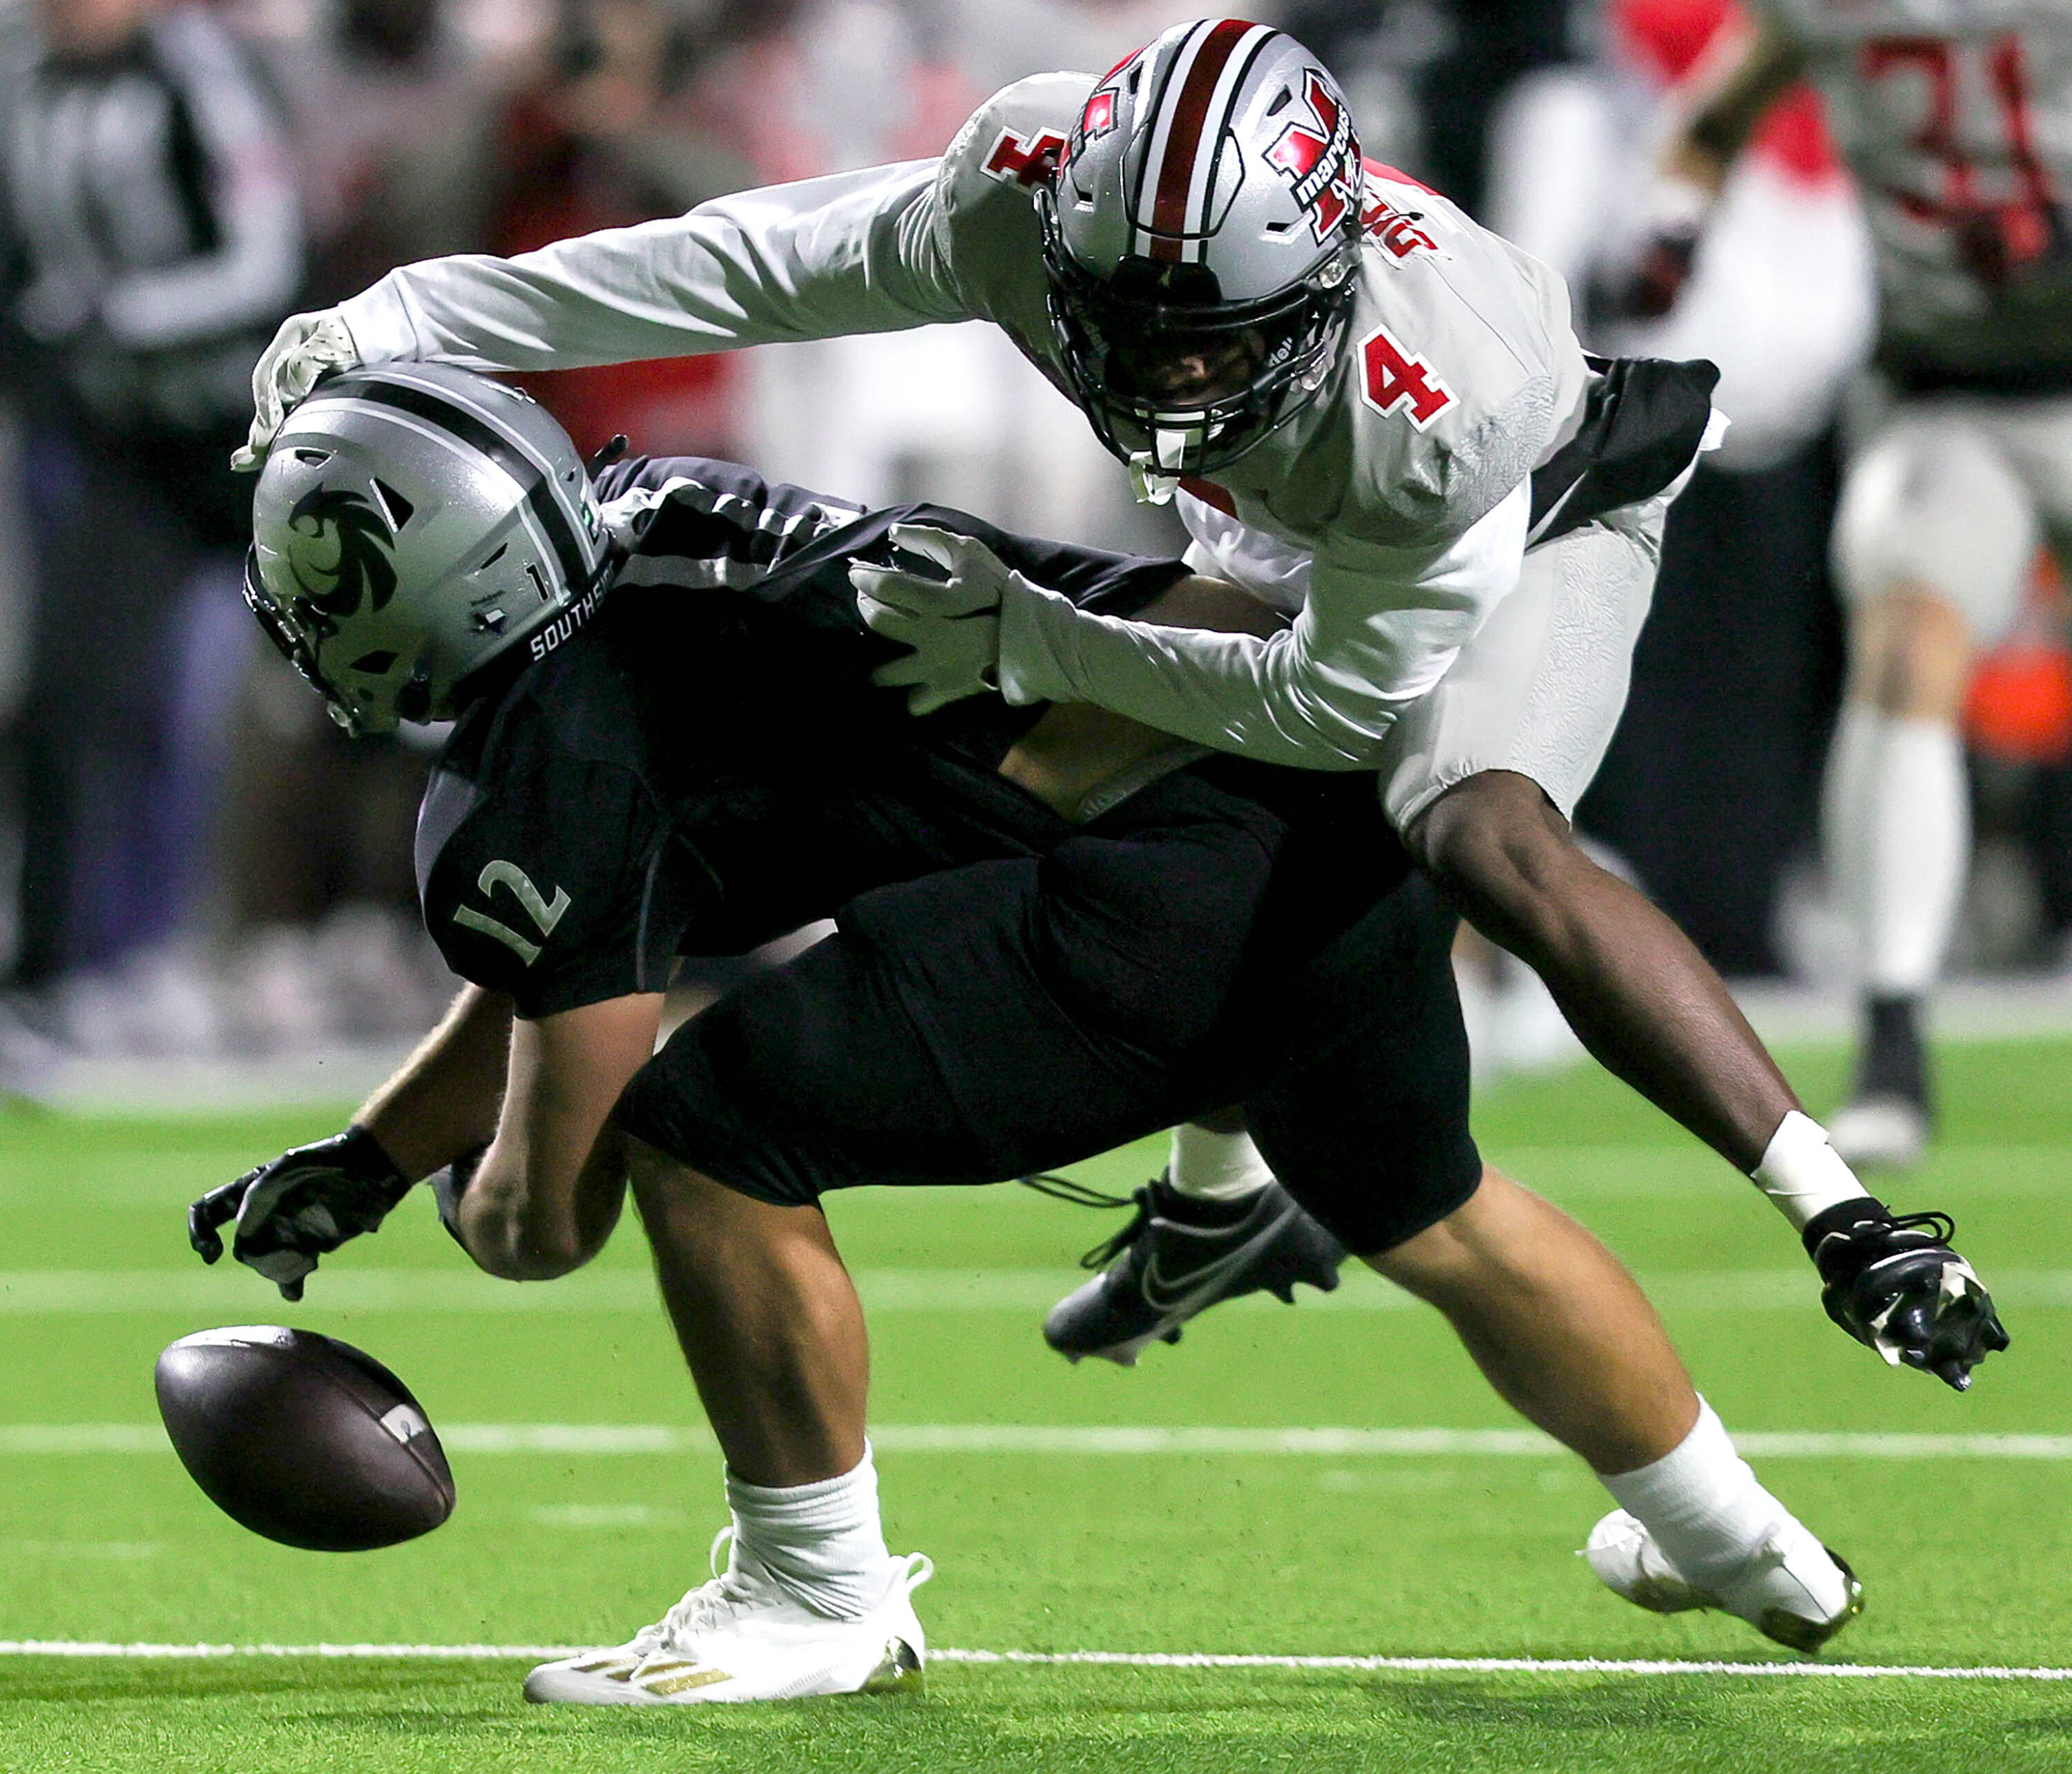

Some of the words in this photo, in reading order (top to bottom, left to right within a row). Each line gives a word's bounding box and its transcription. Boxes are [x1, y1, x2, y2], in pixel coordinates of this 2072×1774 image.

[1295, 103, 1352, 206] marcus
[1358, 323, 1460, 433] 4
[525, 562, 549, 603] 1
[453, 859, 572, 968] 12
